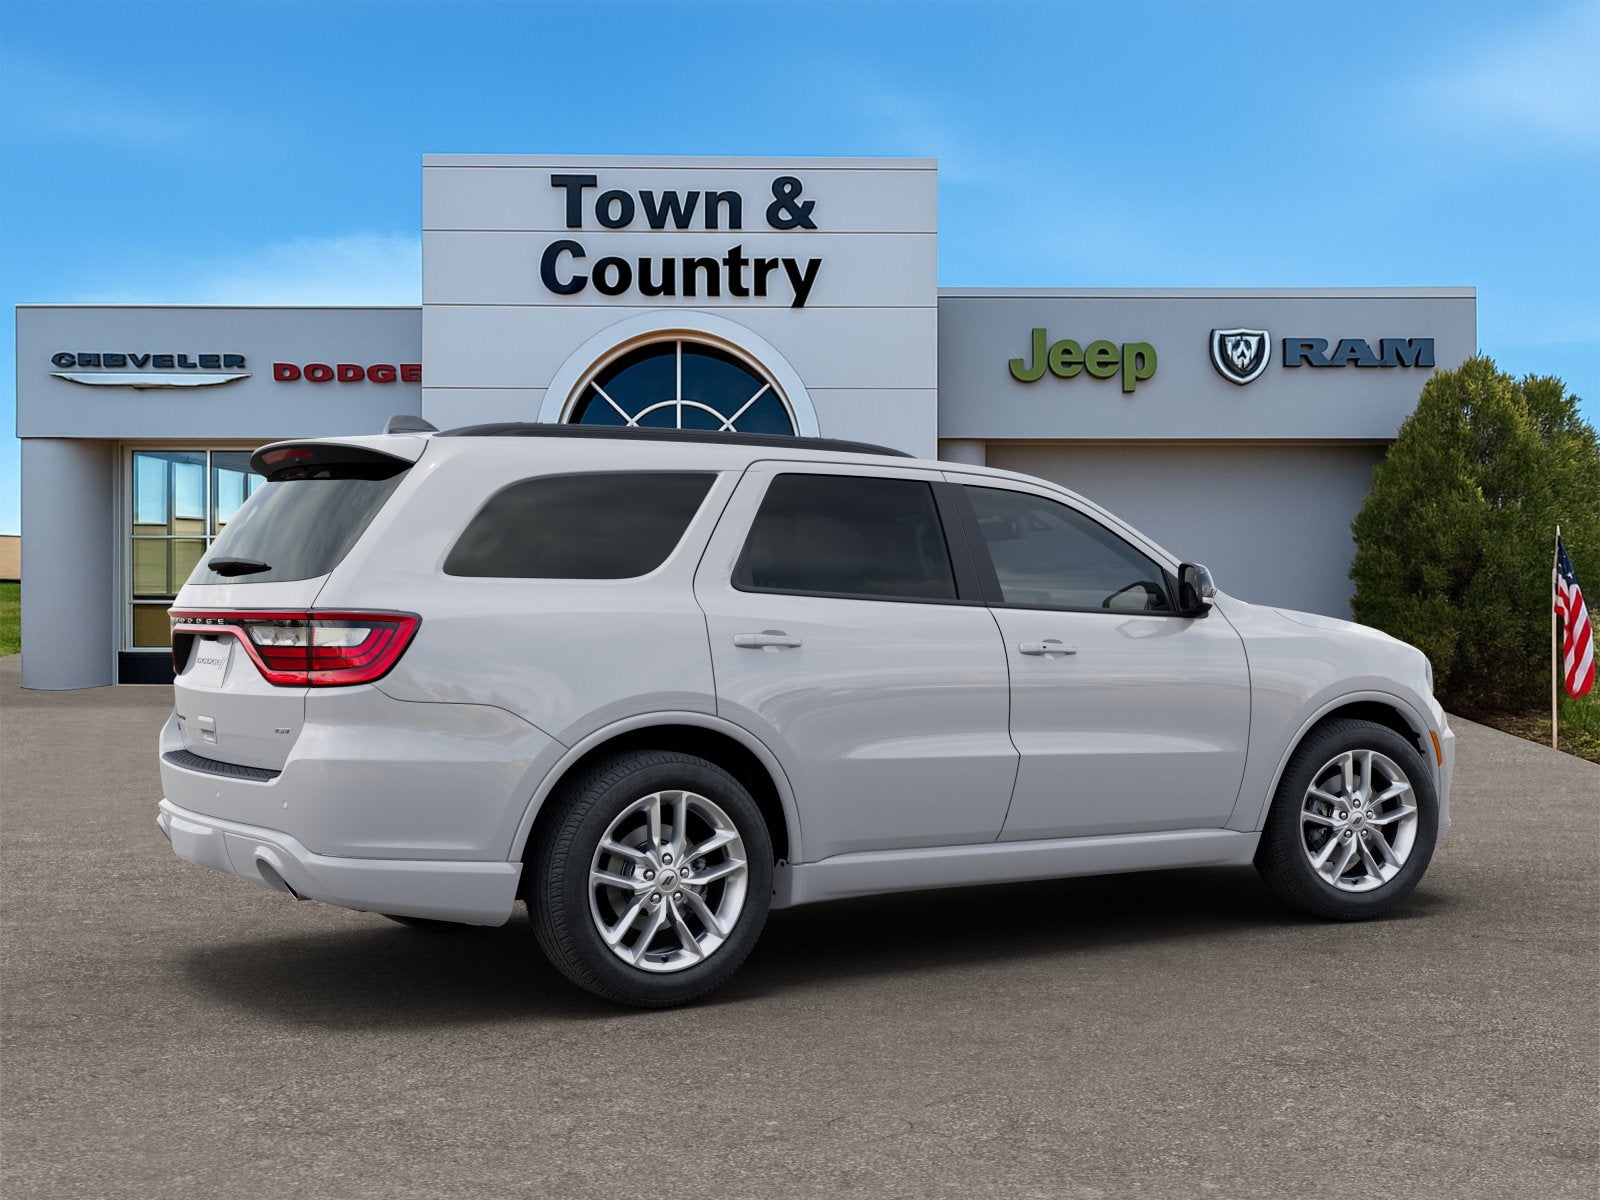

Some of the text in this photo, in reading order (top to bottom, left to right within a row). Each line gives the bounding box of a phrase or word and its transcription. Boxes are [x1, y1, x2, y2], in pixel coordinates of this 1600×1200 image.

[551, 174, 818, 230] Town &
[540, 239, 822, 308] Country
[273, 363, 422, 383] DODGE
[1009, 328, 1157, 393] Jeep
[1282, 337, 1435, 368] RAM
